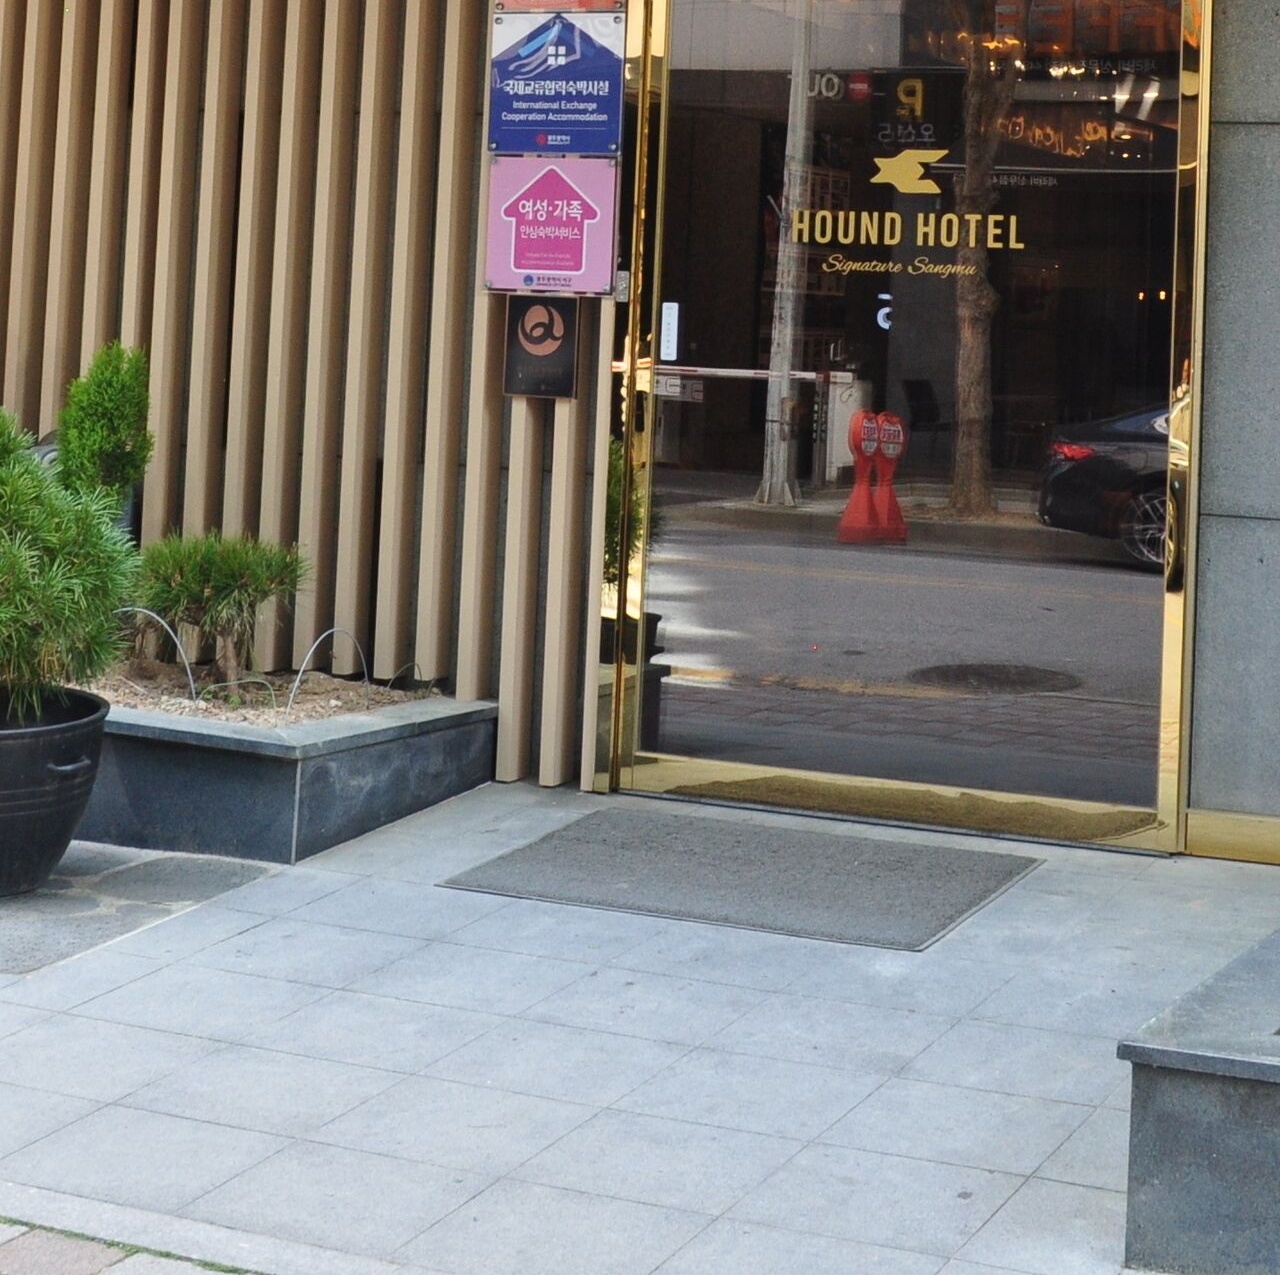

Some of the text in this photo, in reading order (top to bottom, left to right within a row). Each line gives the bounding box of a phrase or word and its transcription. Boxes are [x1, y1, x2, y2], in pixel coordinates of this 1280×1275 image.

[502, 79, 609, 96] 국제교류협력숙박시설
[512, 100, 597, 112] International Exchange
[501, 111, 608, 122] Cooperation Accommodation
[517, 199, 584, 222] 여성·가족
[519, 224, 582, 240] 안심숙박서비스
[791, 209, 1025, 250] HOUND HOTEL
[822, 253, 979, 279] Signature Sangmu
